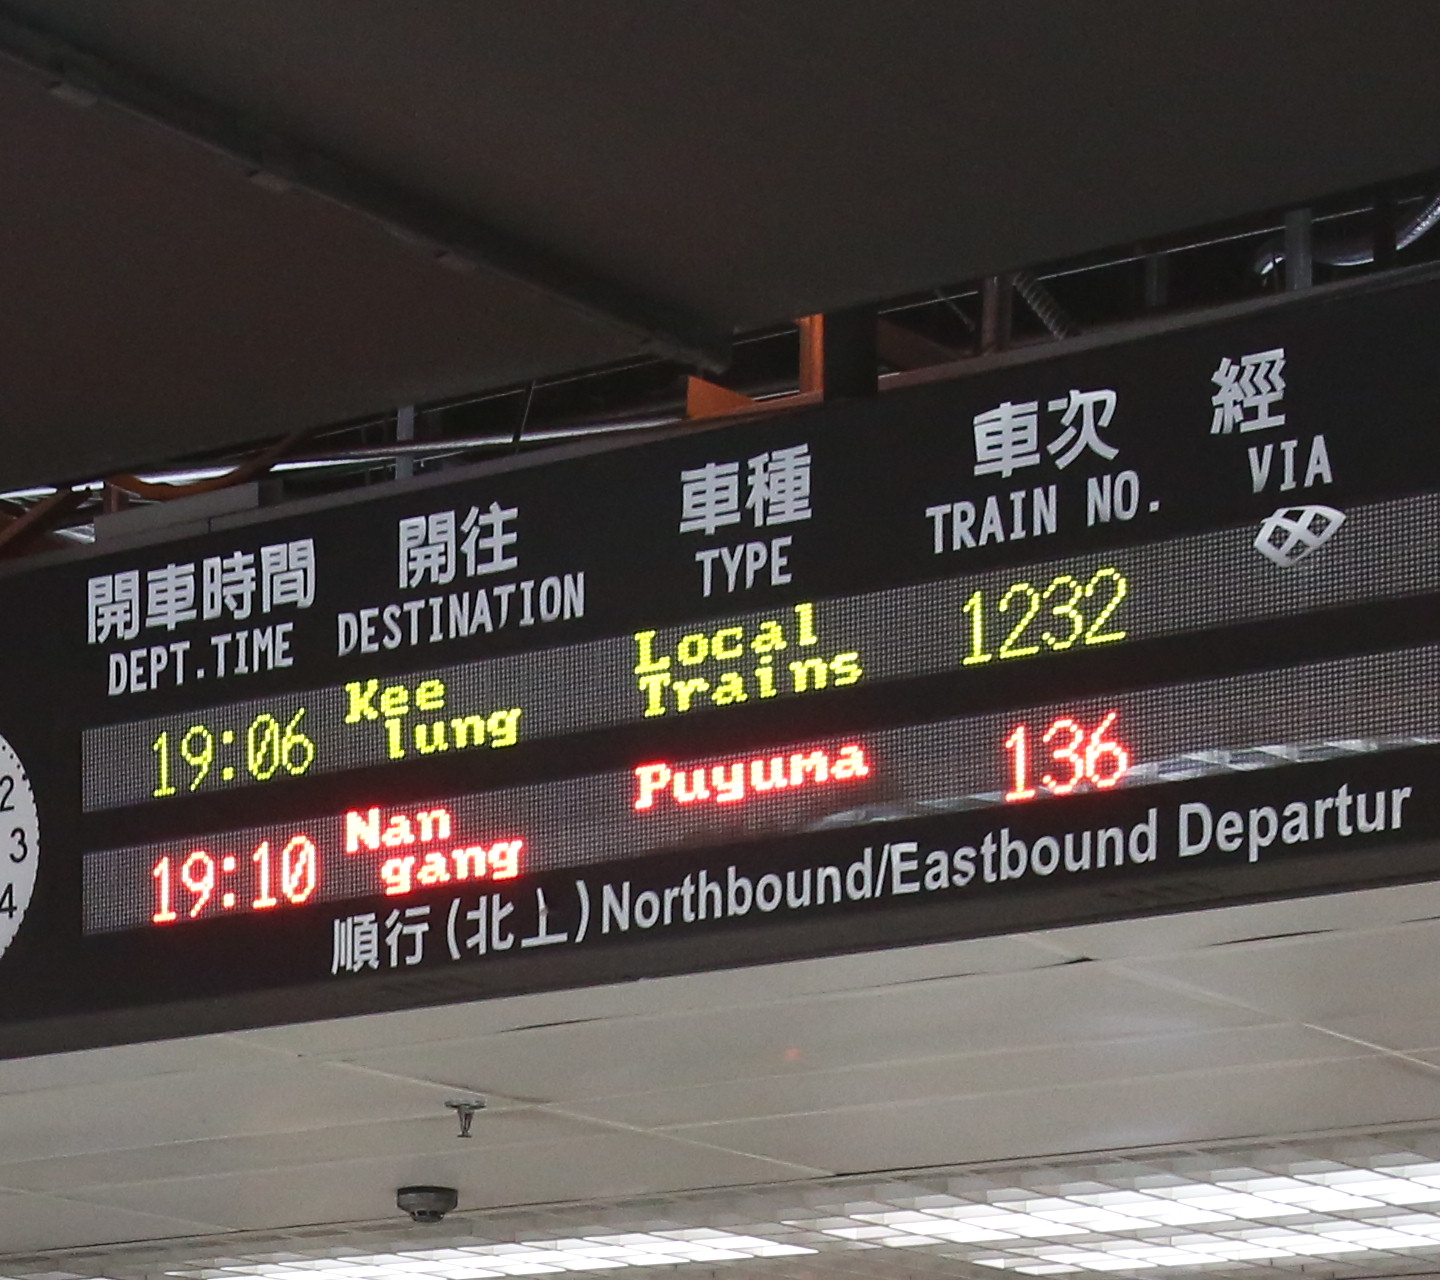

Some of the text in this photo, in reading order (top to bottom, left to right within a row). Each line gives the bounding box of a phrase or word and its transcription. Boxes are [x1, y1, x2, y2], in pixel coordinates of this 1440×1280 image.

[1210, 348, 1286, 435] 經
[973, 389, 1120, 478] 車次
[1248, 435, 1333, 494] VIA
[679, 442, 813, 535] 車種
[926, 470, 1160, 554] TRAIN NO.
[398, 501, 519, 589] 開往
[695, 535, 793, 598] TYPE
[87, 538, 316, 644] 開車時間
[338, 571, 585, 657] DESTINATION
[962, 567, 1127, 666] 1232
[107, 623, 294, 696] DEPT.TIME
[634, 602, 817, 675] Local
[344, 677, 446, 724] Kee
[637, 650, 863, 719] Trains
[151, 707, 316, 798] 19:06
[385, 705, 521, 760] lung
[1005, 711, 1128, 802] 136
[634, 741, 870, 811] Puyuma
[9, 827, 28, 863] 3
[345, 805, 451, 853] Nan
[1178, 784, 1412, 863] Departur
[151, 834, 317, 925] 19:10
[381, 838, 522, 896] gang
